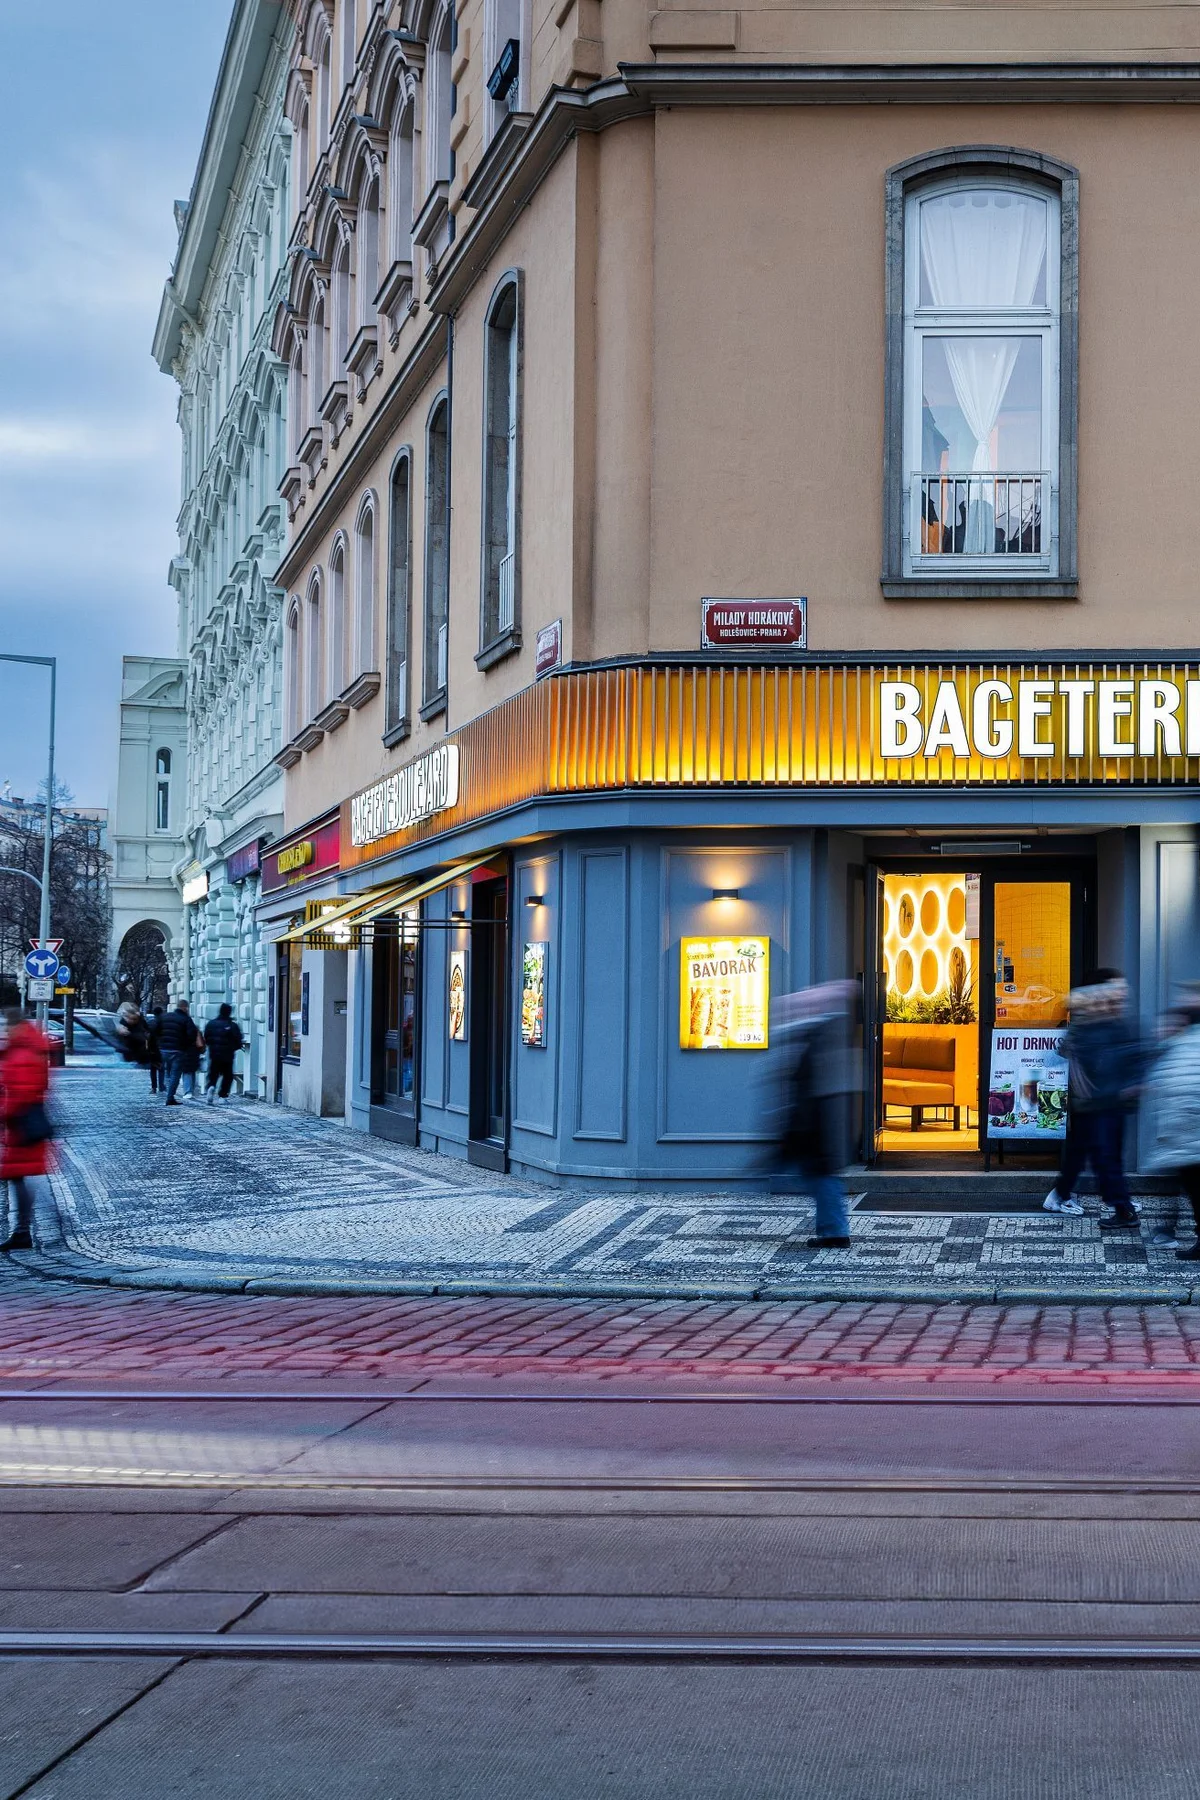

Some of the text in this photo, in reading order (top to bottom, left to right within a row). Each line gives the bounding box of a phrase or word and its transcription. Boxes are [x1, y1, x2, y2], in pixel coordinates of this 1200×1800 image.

[713, 608, 794, 626] MILADY HORÁKOVÉ
[783, 629, 788, 637] 7
[393, 744, 460, 830] BOULEVARD
[996, 1037, 1019, 1051] HOT
